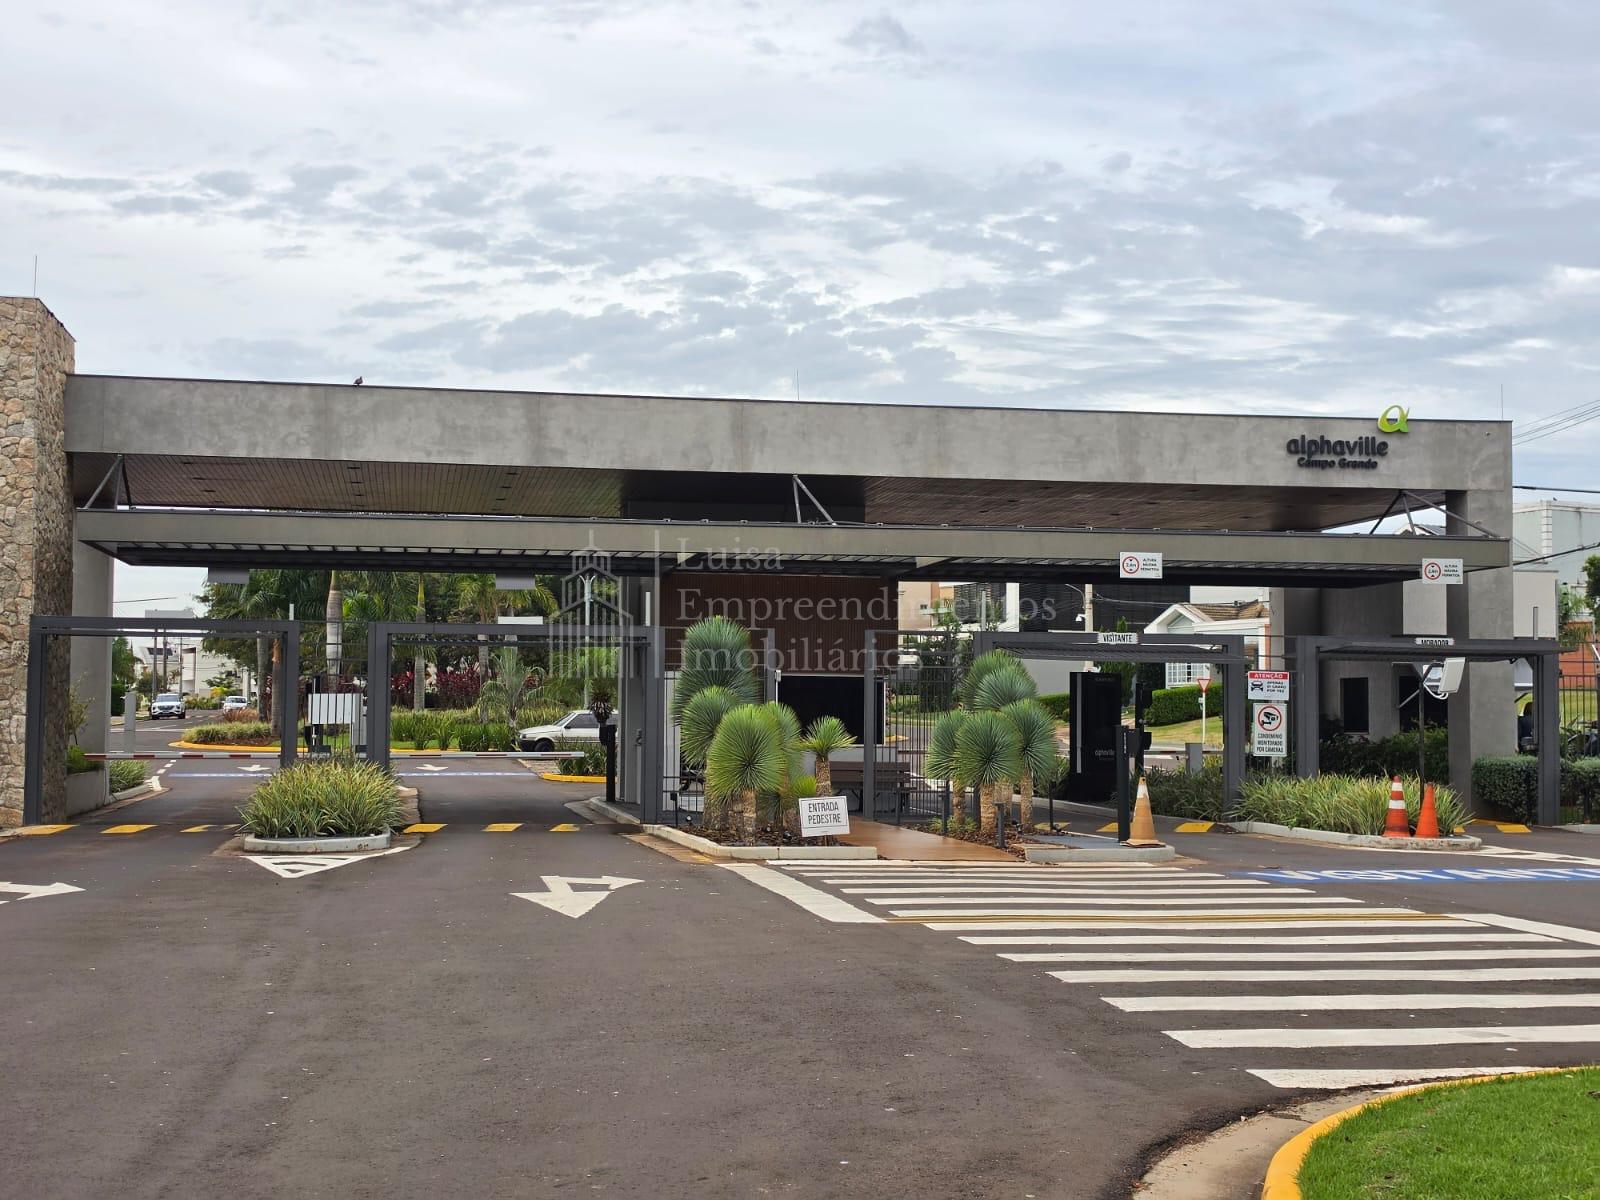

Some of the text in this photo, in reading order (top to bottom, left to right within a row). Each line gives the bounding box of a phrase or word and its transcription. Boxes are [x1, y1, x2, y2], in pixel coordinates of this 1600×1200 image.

[1286, 435, 1389, 460] alphaville
[1297, 457, 1378, 470] Campo Grande
[1102, 633, 1133, 643] VISITANTE
[808, 801, 840, 813] ENTRADA
[807, 813, 842, 825] PEDESTRE
